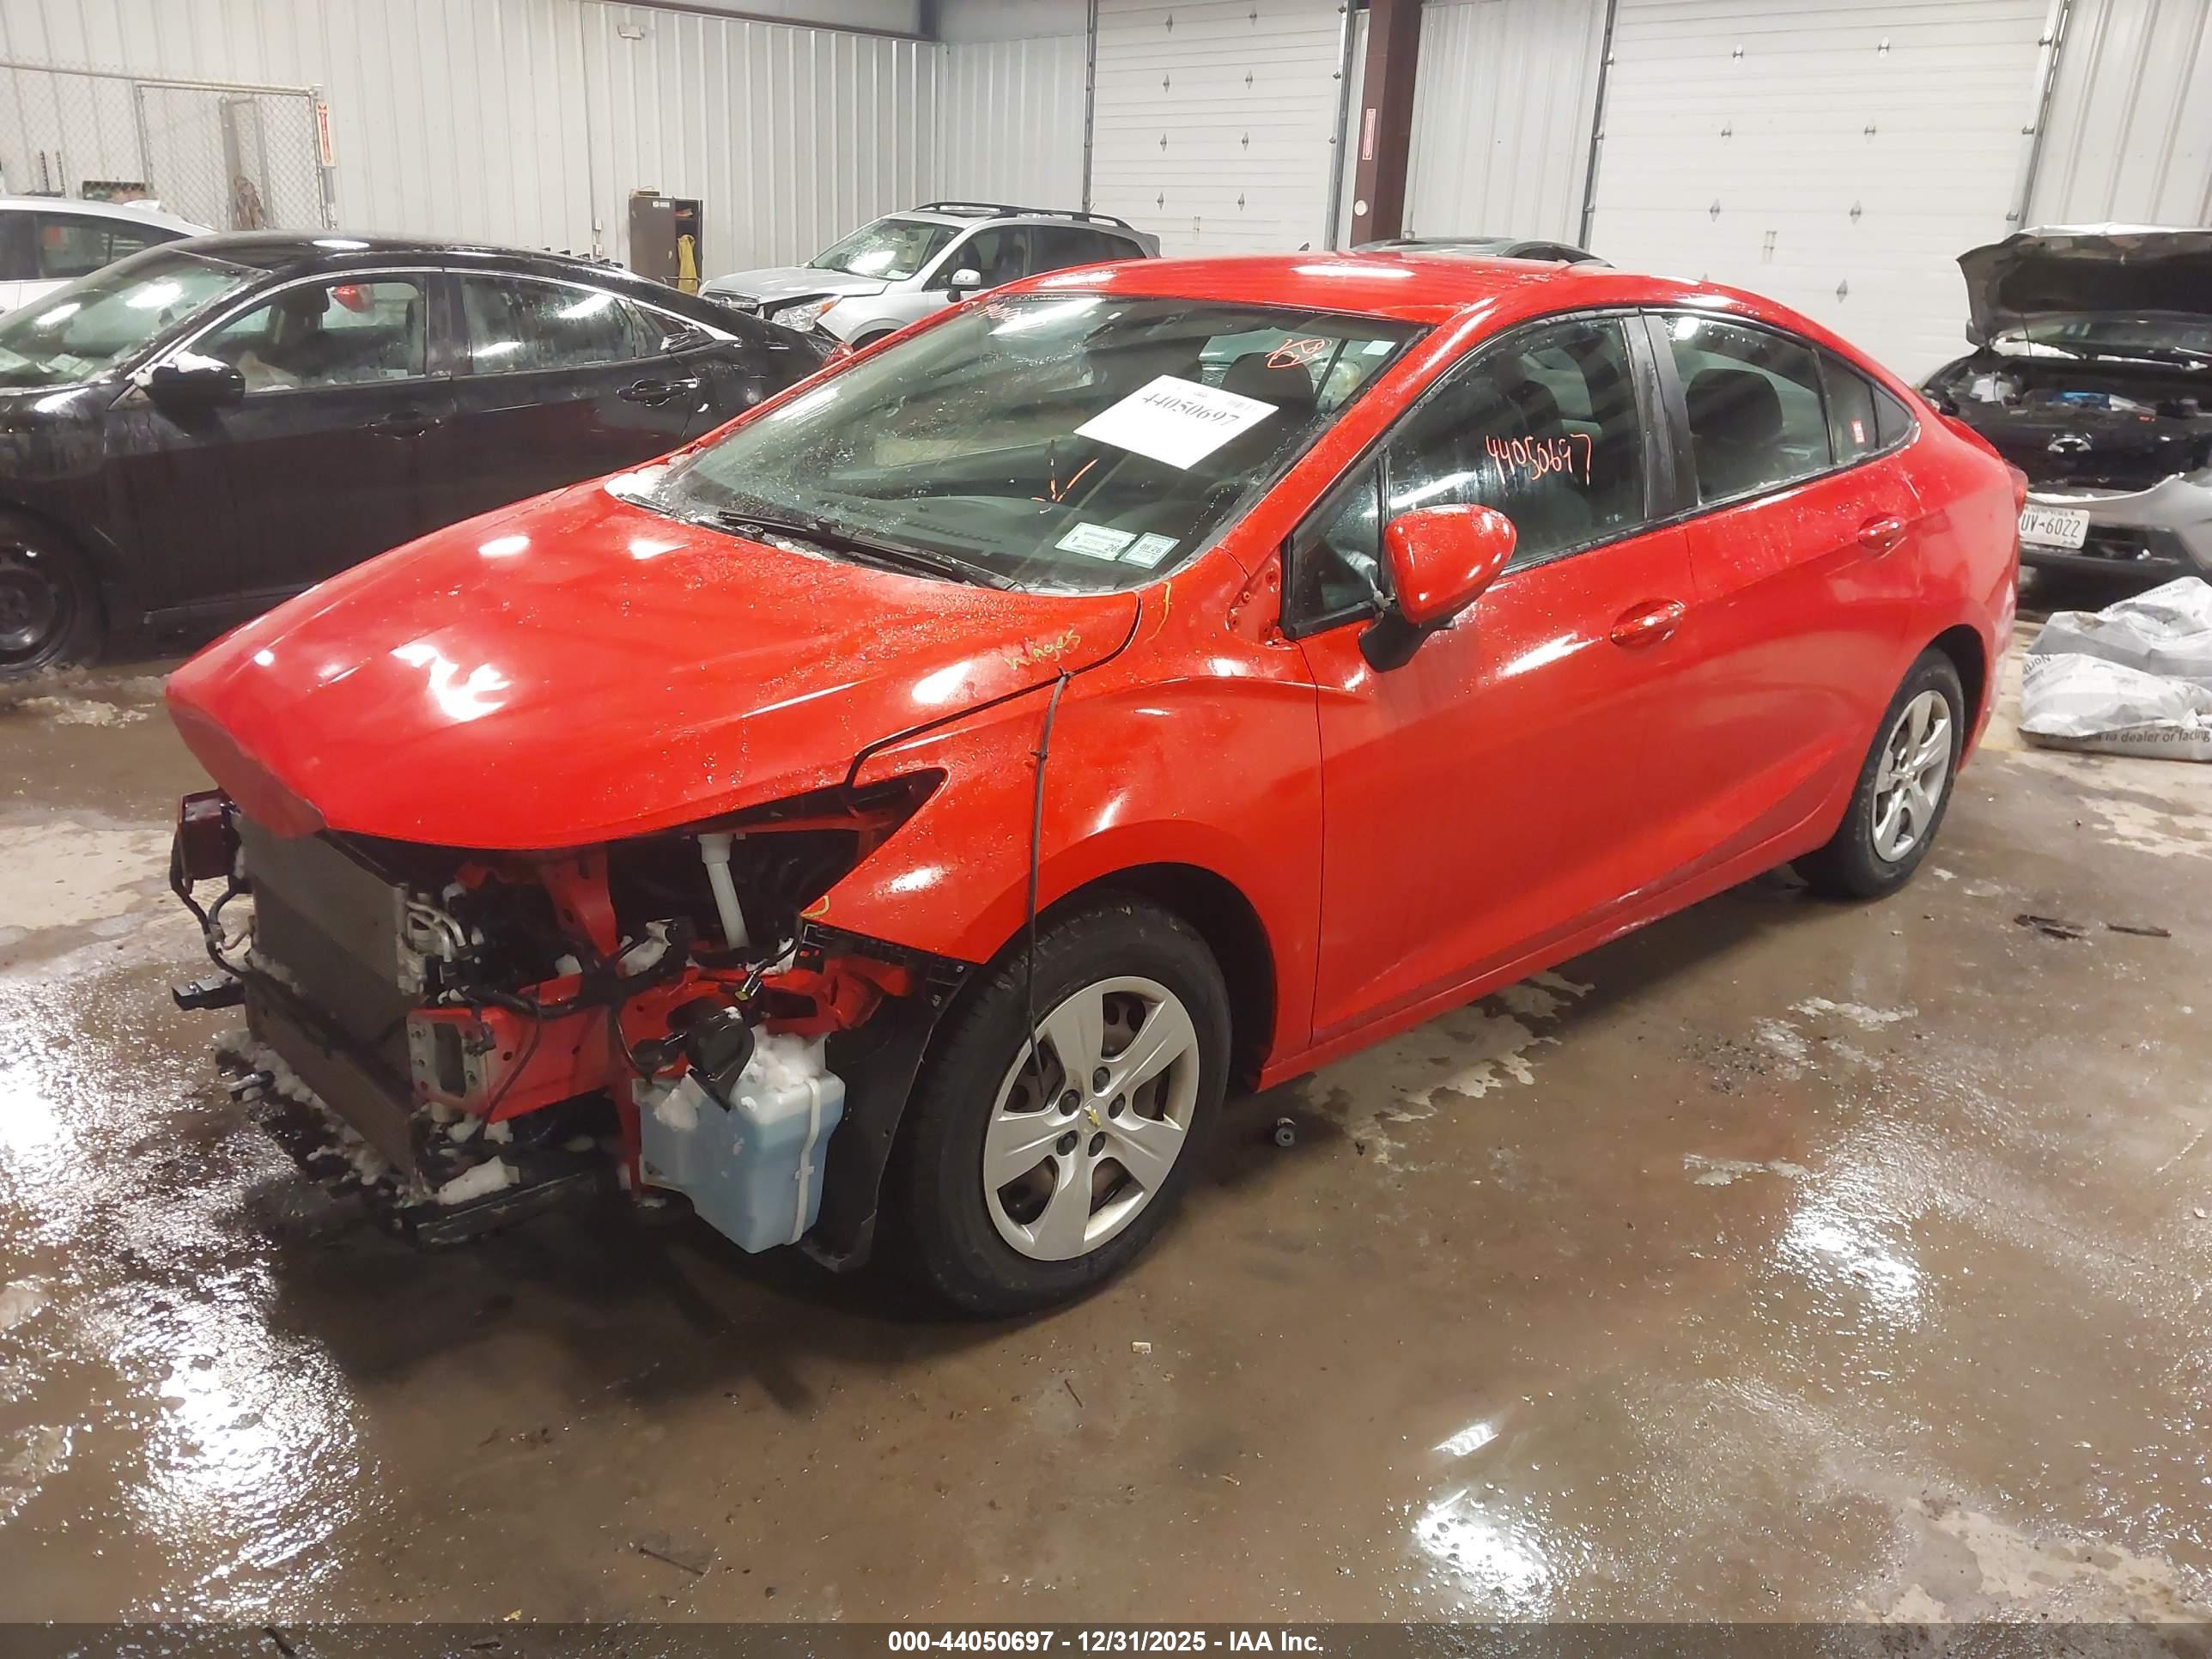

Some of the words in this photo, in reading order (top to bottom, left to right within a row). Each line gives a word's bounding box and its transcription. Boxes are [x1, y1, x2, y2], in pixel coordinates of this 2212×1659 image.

[1142, 392, 1241, 426] 44050697
[1485, 434, 1592, 485] 44050697
[2120, 730, 2160, 743] dealer
[2162, 732, 2176, 743] or
[2177, 727, 2211, 743] facing
